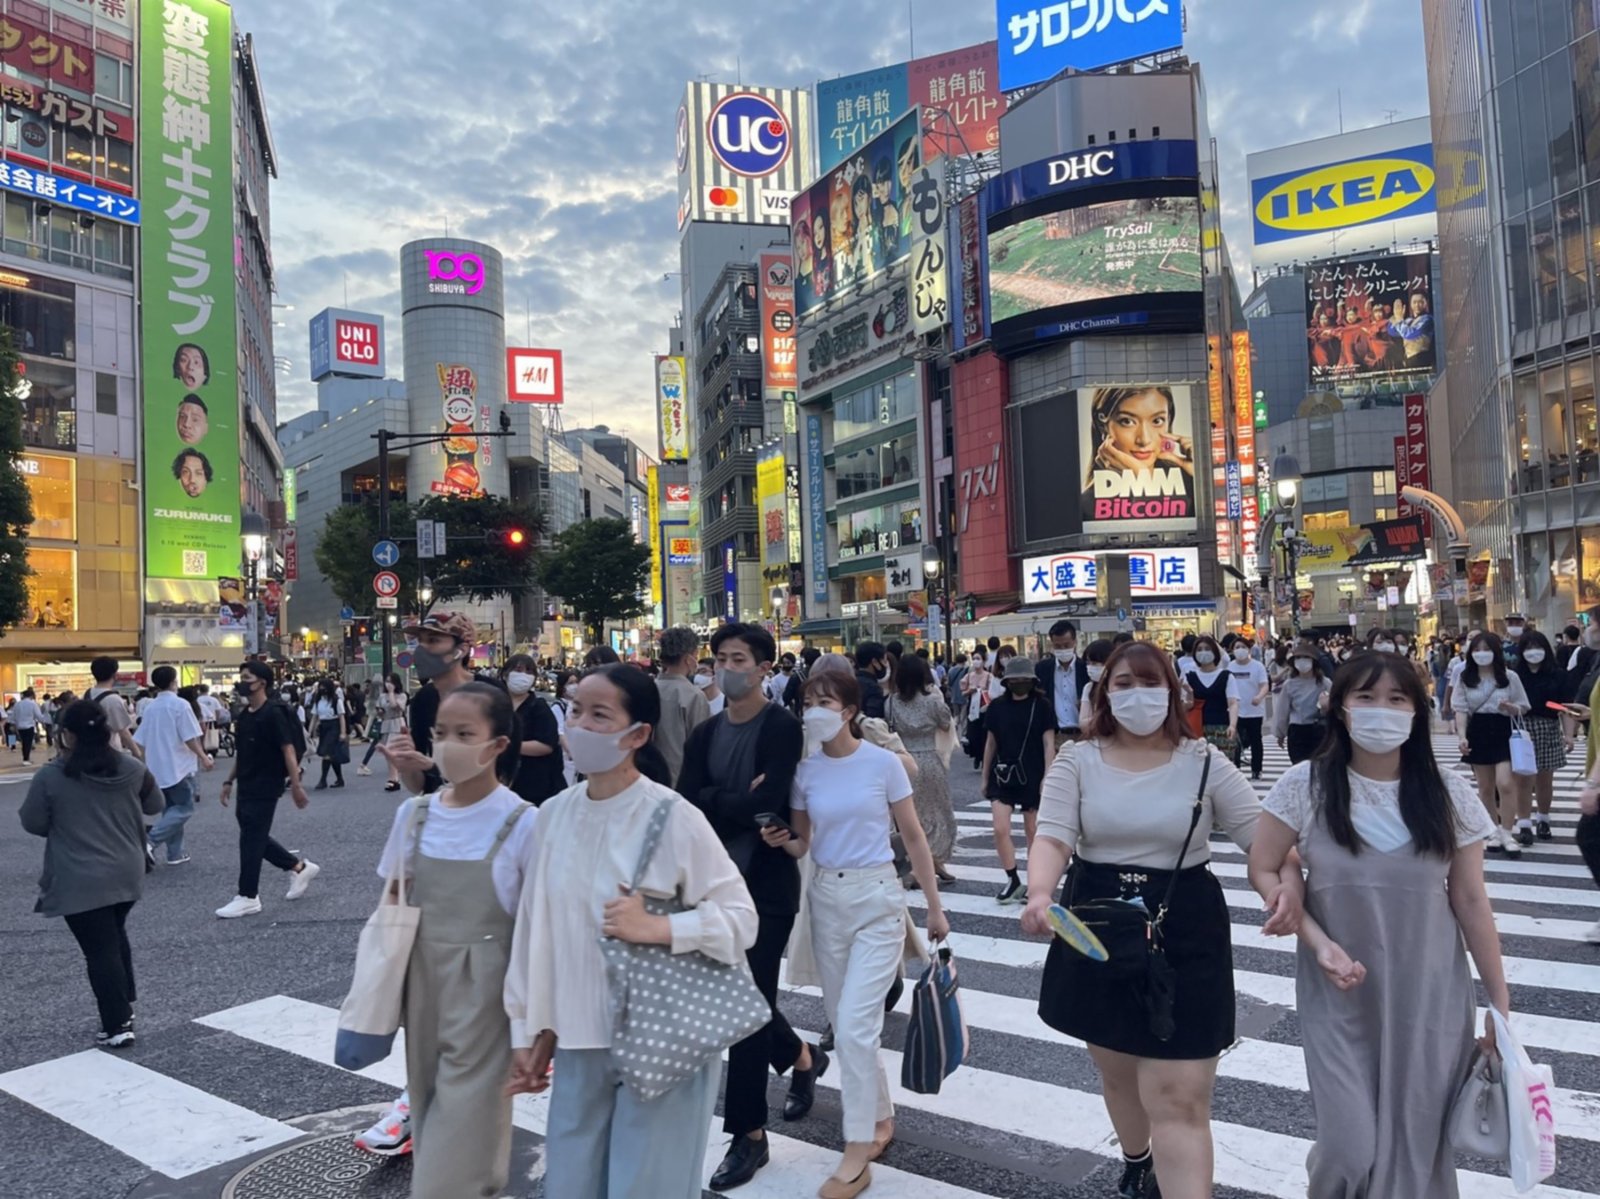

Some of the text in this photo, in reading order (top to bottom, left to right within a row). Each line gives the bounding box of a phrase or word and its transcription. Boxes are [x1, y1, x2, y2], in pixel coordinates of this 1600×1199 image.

[929, 67, 986, 104] 龍角散
[41, 92, 118, 136] ガスト
[837, 89, 890, 123] 龍角散
[162, 2, 215, 335] 変態紳士クラブ
[1048, 151, 1114, 186] DHC
[764, 196, 791, 209] VIS
[1271, 168, 1423, 221] IKEA
[912, 167, 947, 322] もんじゃ
[1103, 222, 1153, 239] TrySail
[425, 250, 486, 295] 109
[429, 283, 465, 294] SHIBUYA
[340, 325, 371, 343] UNI
[1059, 316, 1120, 332] DHC Channel
[341, 342, 375, 360] QLO
[521, 366, 549, 384] H&M
[1408, 404, 1426, 475] カラオケ
[1093, 467, 1187, 498] DMM
[153, 508, 233, 523] ZURUMUKE
[1095, 497, 1187, 519] Bitcoin
